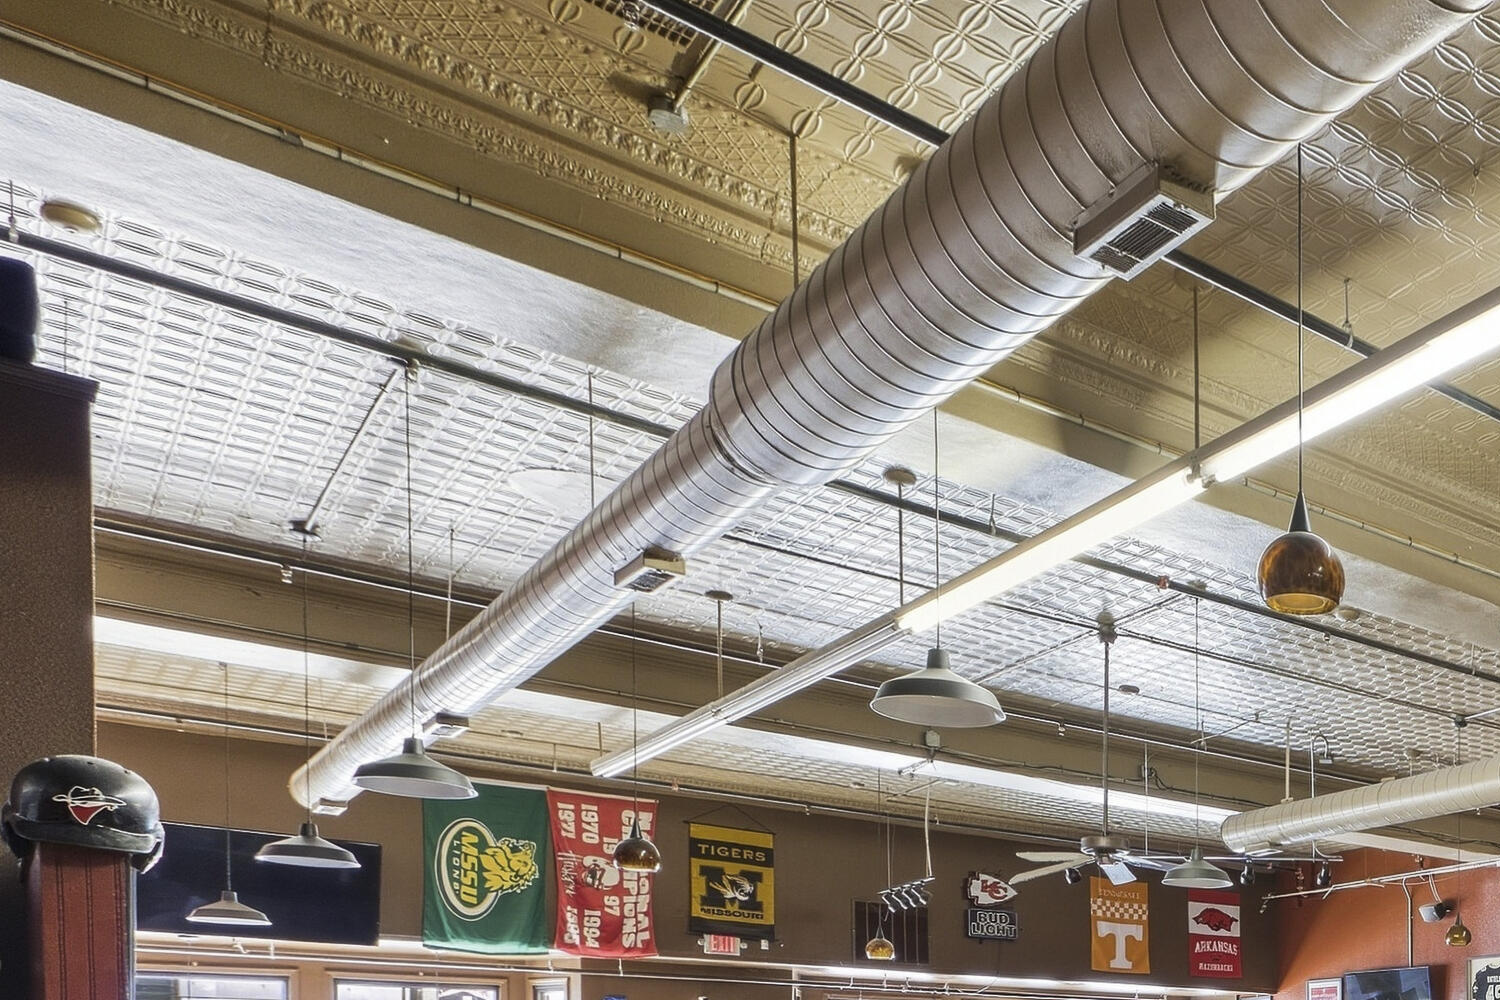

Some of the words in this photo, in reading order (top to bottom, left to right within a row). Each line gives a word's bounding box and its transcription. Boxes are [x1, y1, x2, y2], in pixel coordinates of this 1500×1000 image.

[557, 802, 576, 839] 1971
[581, 803, 600, 844] 1970
[451, 840, 461, 890] LIONS
[698, 843, 766, 861] TIGERS
[460, 831, 479, 904] MSSU
[621, 809, 638, 949] CHPIONS
[637, 811, 653, 948] NIONAL
[981, 880, 1008, 900] KC
[701, 906, 764, 920] MISSOURI
[977, 911, 1010, 925] BUD
[711, 933, 736, 953] EXIT
[971, 922, 1016, 937] LIGHT
[1097, 921, 1143, 969] T
[1195, 940, 1238, 956] ARKANSAS
